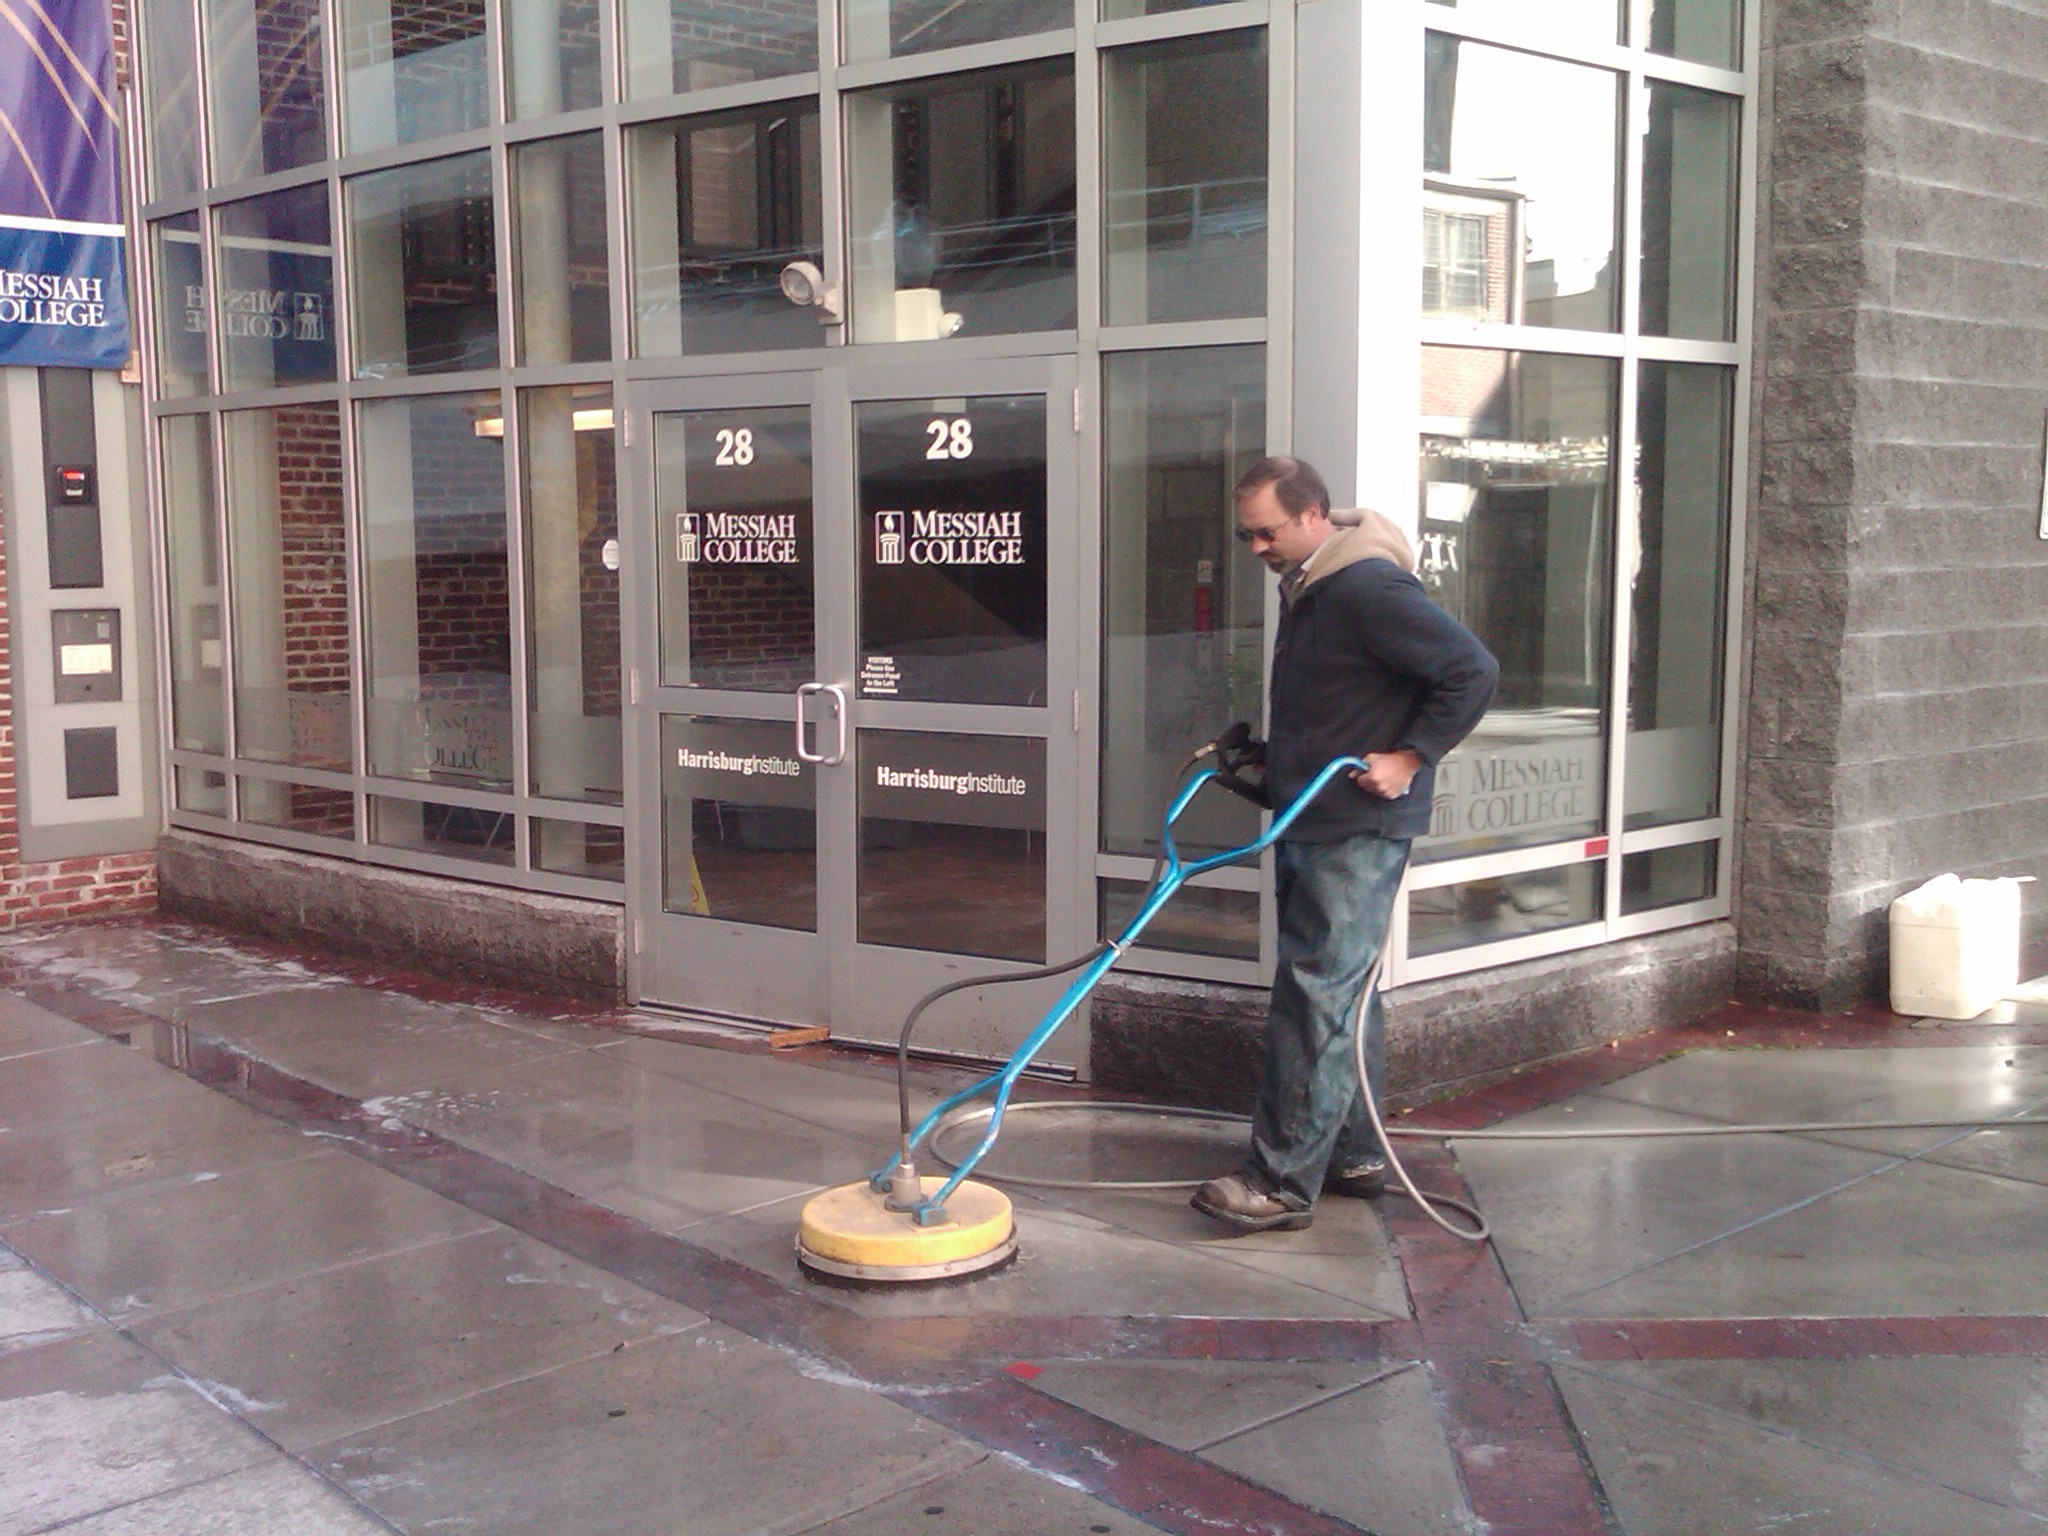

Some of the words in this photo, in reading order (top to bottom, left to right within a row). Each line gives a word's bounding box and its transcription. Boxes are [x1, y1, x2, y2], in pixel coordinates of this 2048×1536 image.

[0, 268, 104, 302] ESSIAH
[0, 298, 106, 327] OLLEGE
[716, 429, 754, 466] 28
[926, 419, 974, 460] 28
[705, 512, 796, 539] MESSIAH
[911, 510, 1022, 538] MESSIAH
[703, 539, 799, 563] COLLEGE
[909, 539, 1024, 564] COLLEGE
[1471, 756, 1583, 795] MESSIAH
[1468, 785, 1584, 832] COLLEGE
